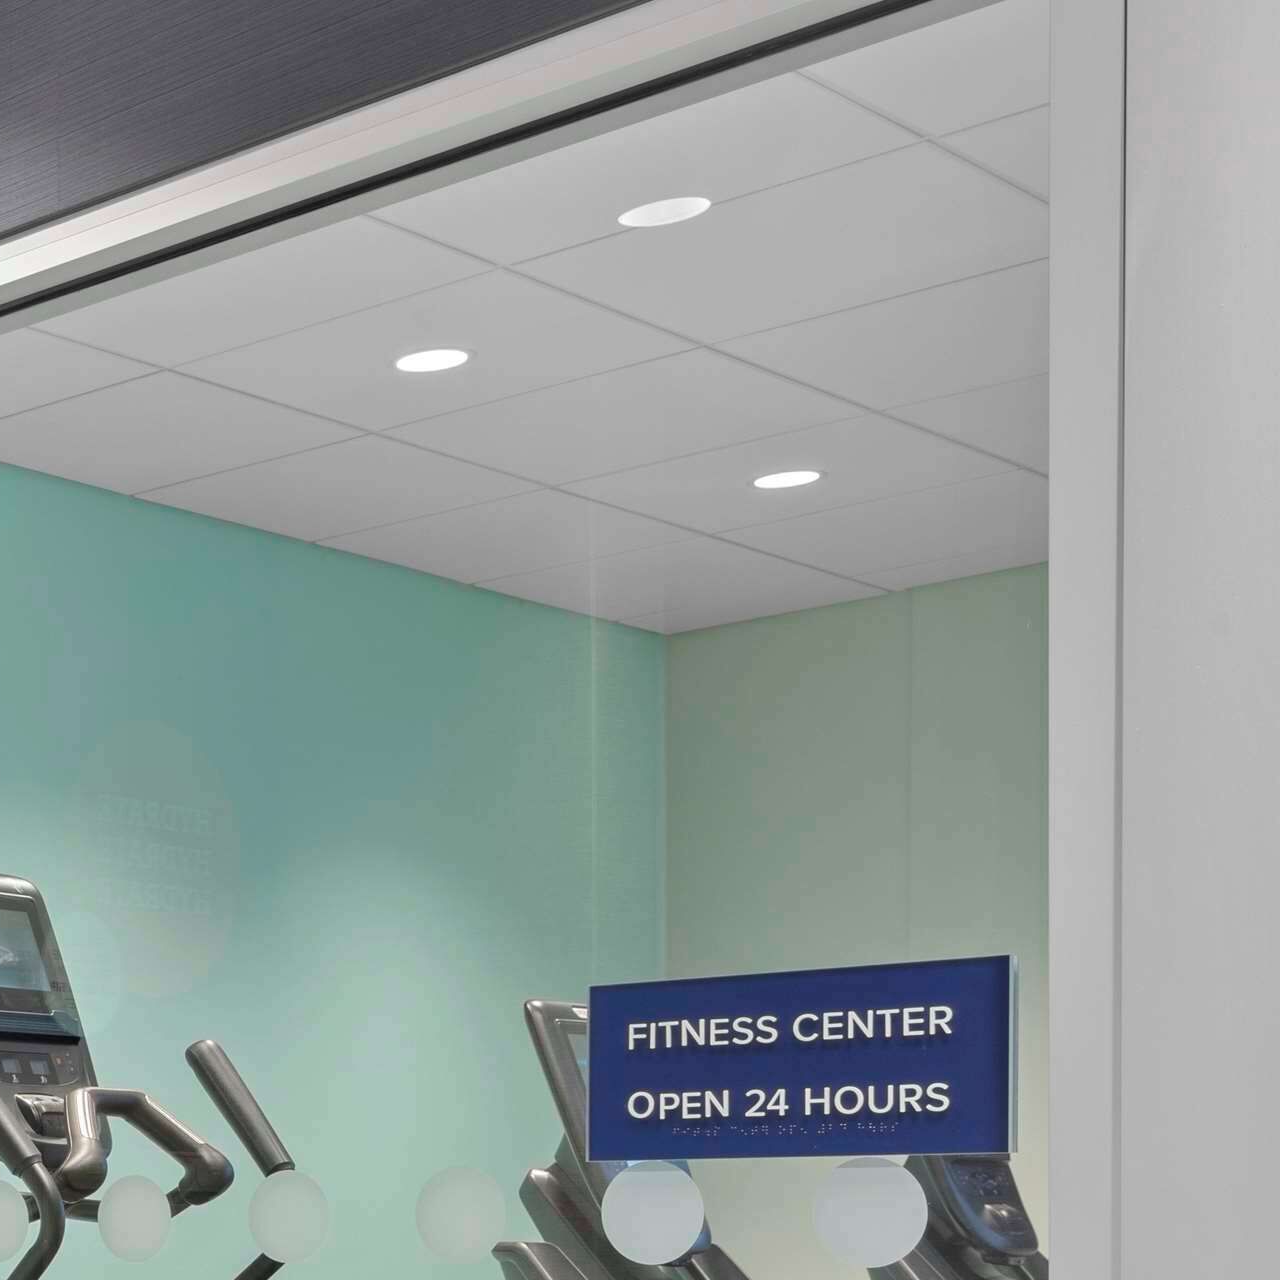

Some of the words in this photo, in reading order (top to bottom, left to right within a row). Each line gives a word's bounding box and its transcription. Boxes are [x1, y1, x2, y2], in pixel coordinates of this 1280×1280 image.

[627, 1015, 778, 1050] FITNESS
[792, 1006, 954, 1042] CENTER
[627, 1089, 730, 1120] OPEN
[744, 1088, 789, 1117] 24
[804, 1082, 951, 1116] HOURS
